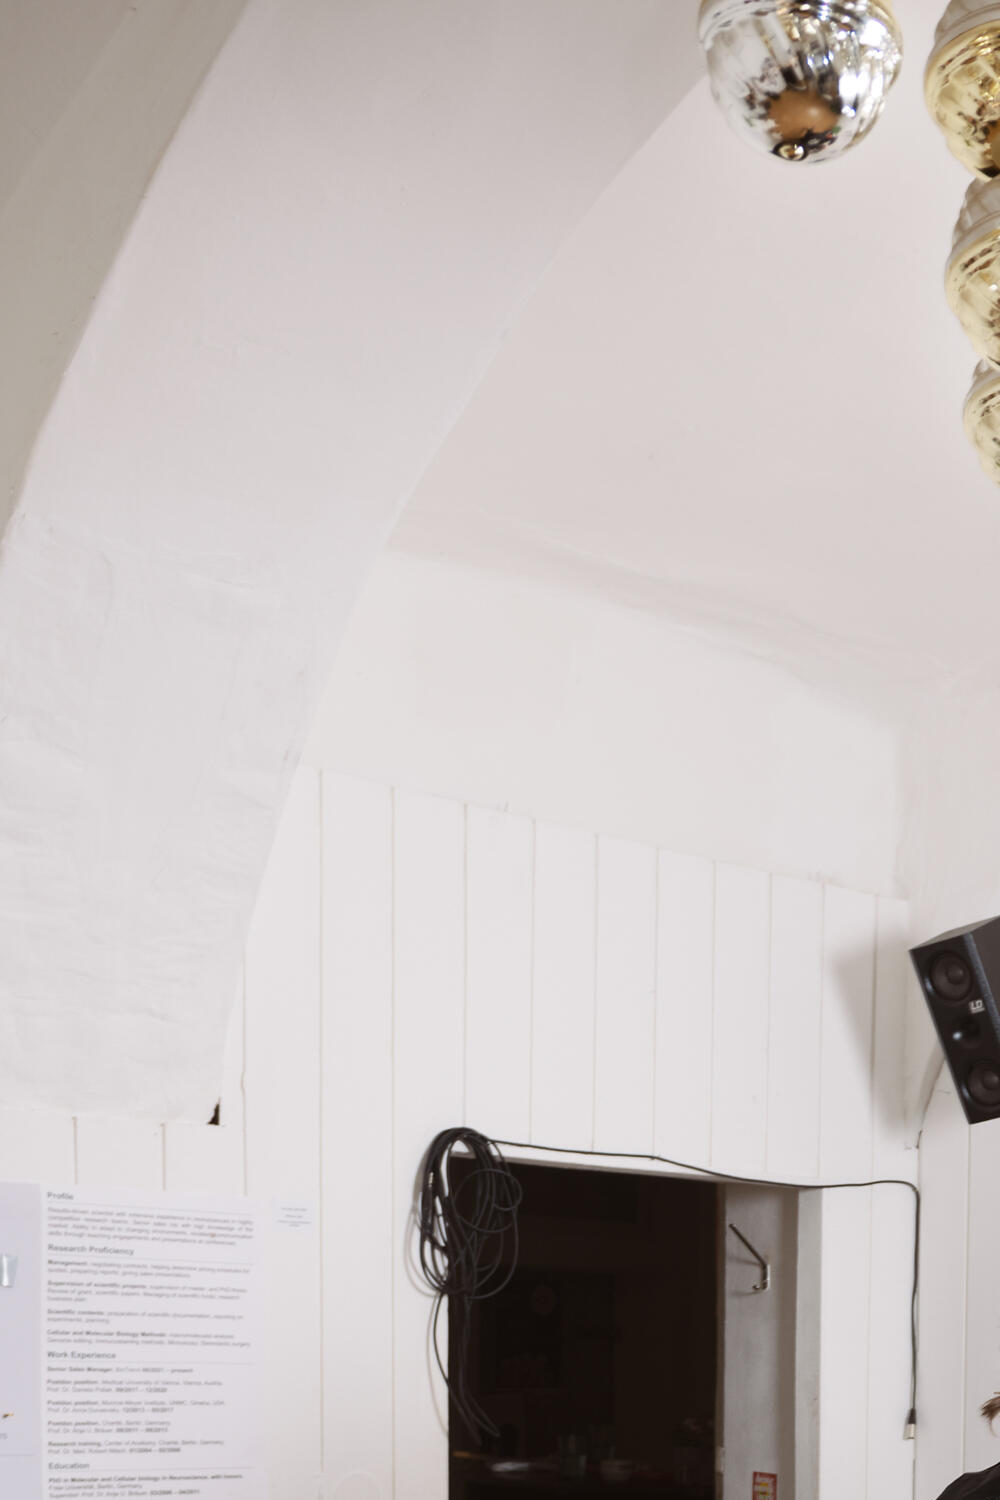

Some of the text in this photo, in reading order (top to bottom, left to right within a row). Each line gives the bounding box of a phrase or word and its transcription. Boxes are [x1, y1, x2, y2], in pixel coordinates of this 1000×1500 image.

[47, 1192, 73, 1200] Profile
[48, 1244, 134, 1255] Research Proficiency
